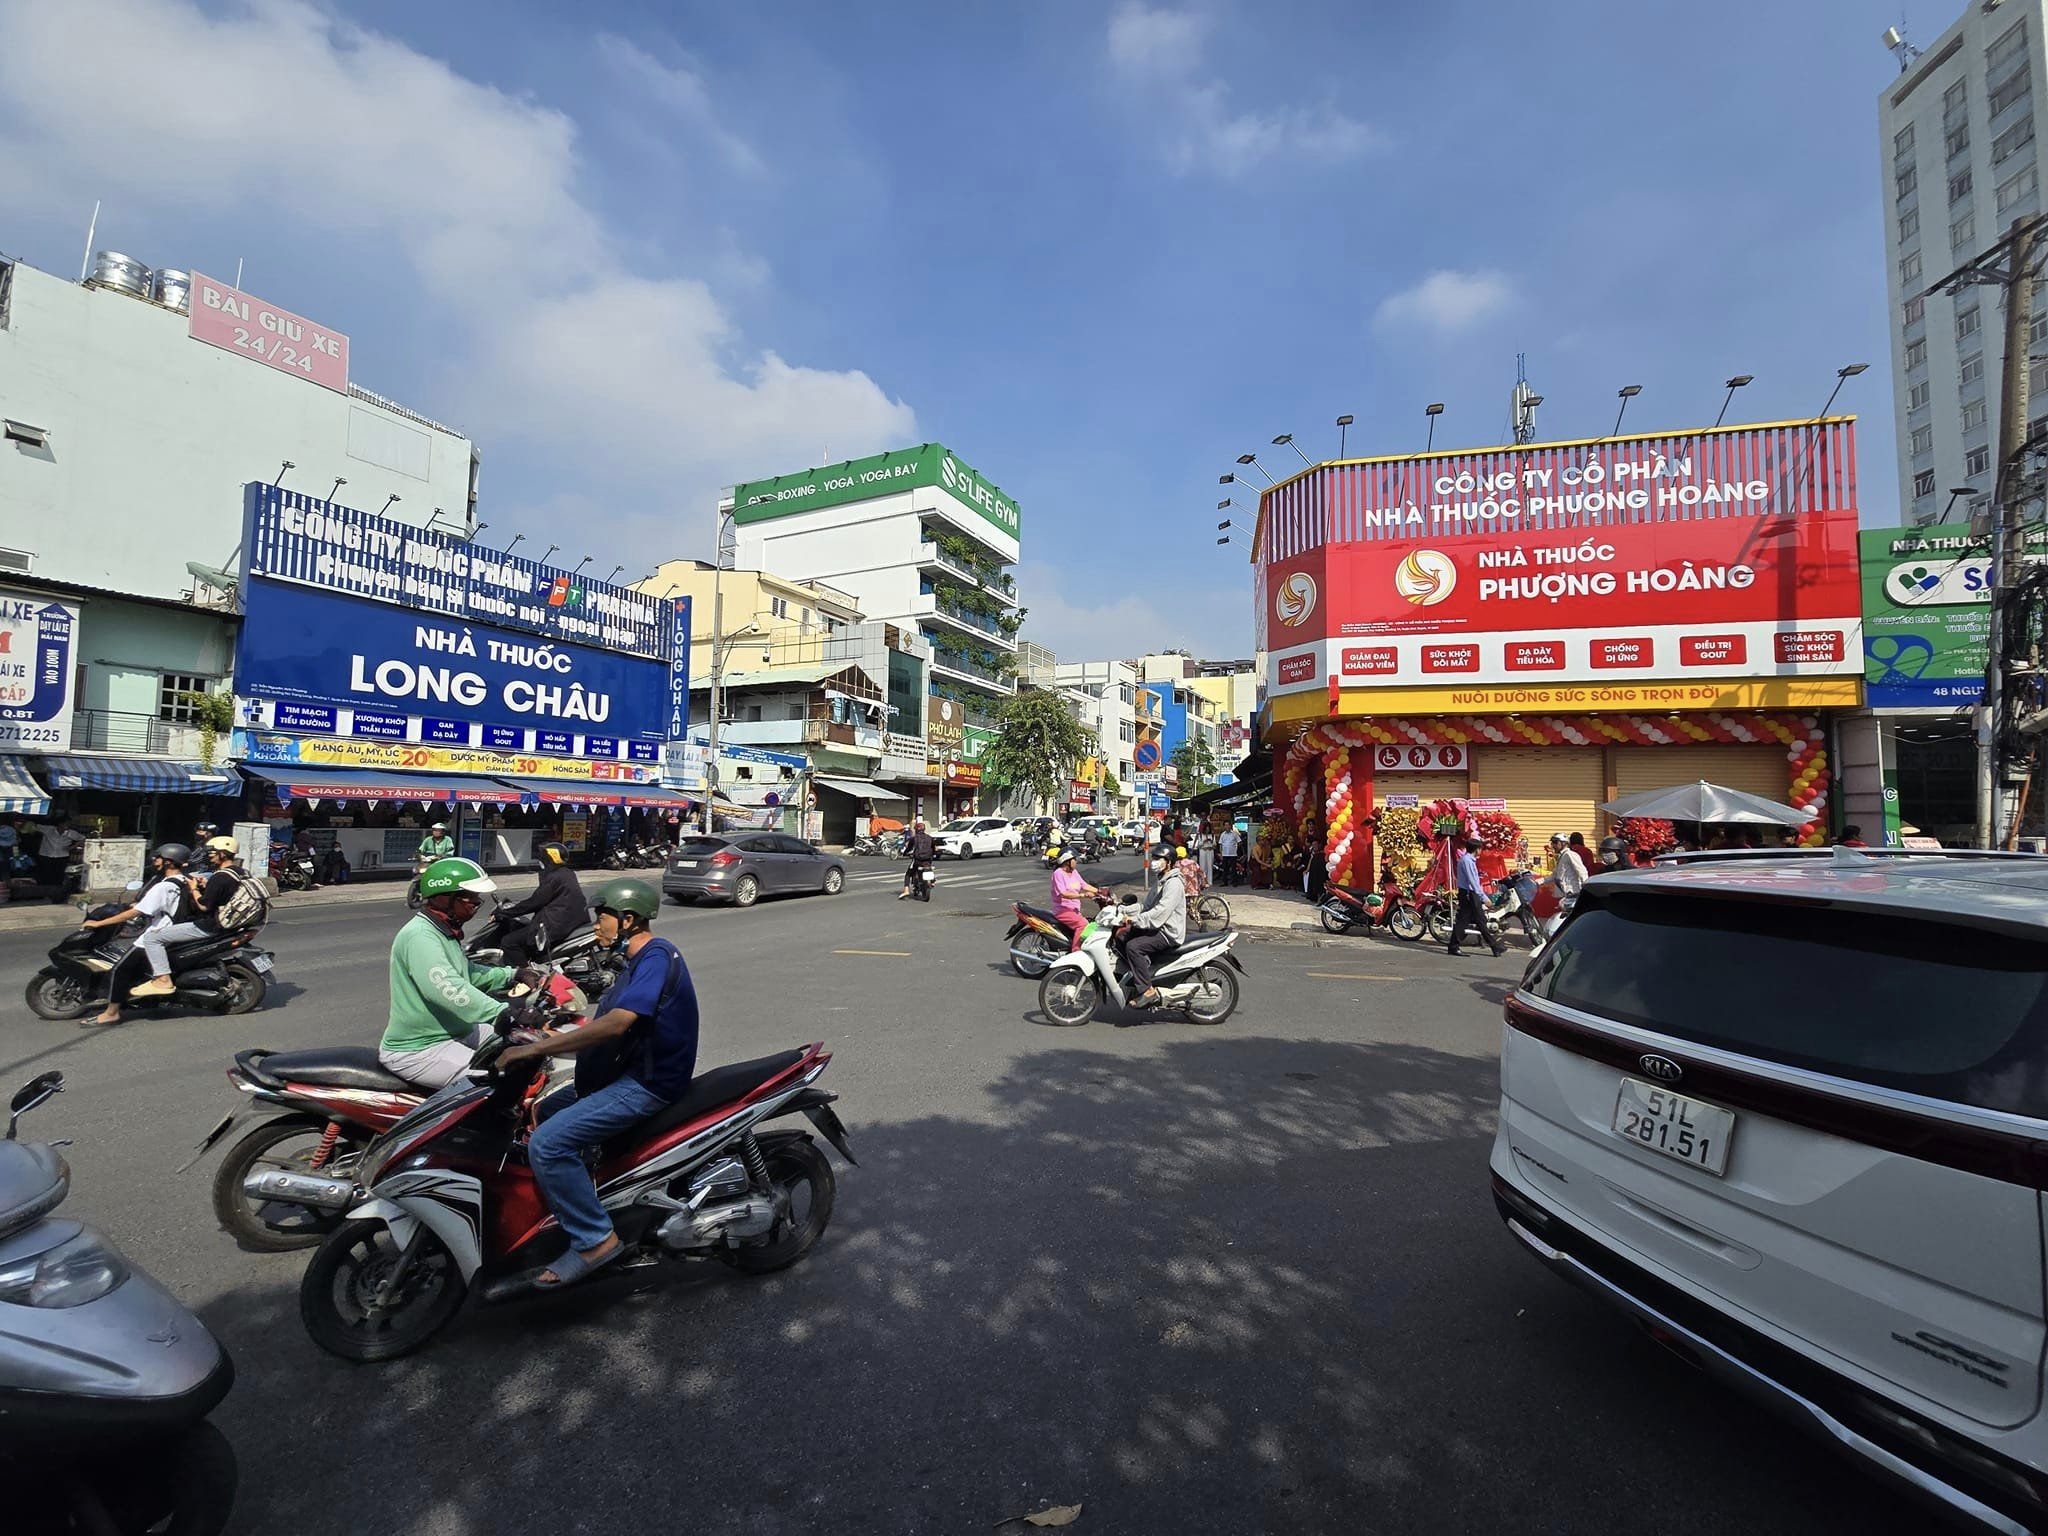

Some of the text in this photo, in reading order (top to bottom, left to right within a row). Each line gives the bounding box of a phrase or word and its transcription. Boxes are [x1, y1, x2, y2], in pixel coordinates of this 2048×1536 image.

[203, 286, 249, 322] BÃI
[312, 332, 341, 360] XE
[233, 327, 313, 373] 24/24
[1435, 449, 1692, 496] CÔNG TY CỔ PHẦN
[777, 462, 919, 502] BOXING YOGA YOGA BAY
[958, 472, 1018, 530] S'LIFE GYM
[1365, 478, 1769, 528] NHÀ THUỐC PHƯỢNG HOÀNG
[1479, 536, 1615, 569] NHÀ THUỐC
[283, 506, 362, 552] CÔNG
[365, 528, 401, 561] TY
[470, 559, 533, 594] PHẨM
[586, 590, 655, 626] PHARMA
[1479, 560, 1755, 604] PHƯỢNG HOÀNG
[13, 602, 34, 621] XE
[468, 592, 516, 617] thuốc
[519, 603, 545, 627] nội
[558, 614, 600, 637] ngoại
[61, 623, 70, 634] XE
[1945, 622, 1982, 633] THUỐC
[1782, 632, 1837, 643] CHĂM SÓC
[415, 626, 572, 674] NHÀ THUỐC
[1518, 646, 1552, 657] DẠ DÀY
[1604, 642, 1640, 653] CHỐNG
[1718, 641, 1732, 650] TRỊ
[1784, 641, 1805, 652] SỨC
[1373, 652, 1391, 660] ĐAU
[1429, 650, 1446, 658] SỨC
[1516, 654, 1555, 665] TIÊU HÓA
[1606, 652, 1638, 663] DỊ ỨNG
[1700, 651, 1727, 659] GOUT
[1787, 653, 1810, 662] SINH
[12, 664, 25, 678] XE
[1345, 661, 1374, 670] KHÁNG
[671, 618, 685, 736] LONG CHÂU
[351, 654, 609, 723] LONG CHÂU
[1452, 684, 1719, 704] NUÔI DƯỠNG SỨC SỐNG TRỌN ĐỜI
[1933, 687, 1948, 696] 48
[2, 708, 35, 719] Q.BT
[285, 706, 328, 717] TIM MẠCH
[355, 714, 384, 724] XƯƠNG
[382, 726, 401, 736] KINH
[929, 720, 944, 736] PHỞ
[433, 731, 459, 739] DẠ DÀY
[494, 738, 512, 746] GOUT
[380, 759, 400, 767] NGAY
[308, 787, 343, 795] GIAO
[346, 786, 383, 796] HÀNG
[387, 789, 412, 798] TẬN
[427, 876, 453, 888] Grab
[428, 966, 471, 1007] Grab
[1644, 1057, 1675, 1079] KIA
[1648, 1090, 1694, 1129] 51L
[1623, 1111, 1710, 1165] 281.51
